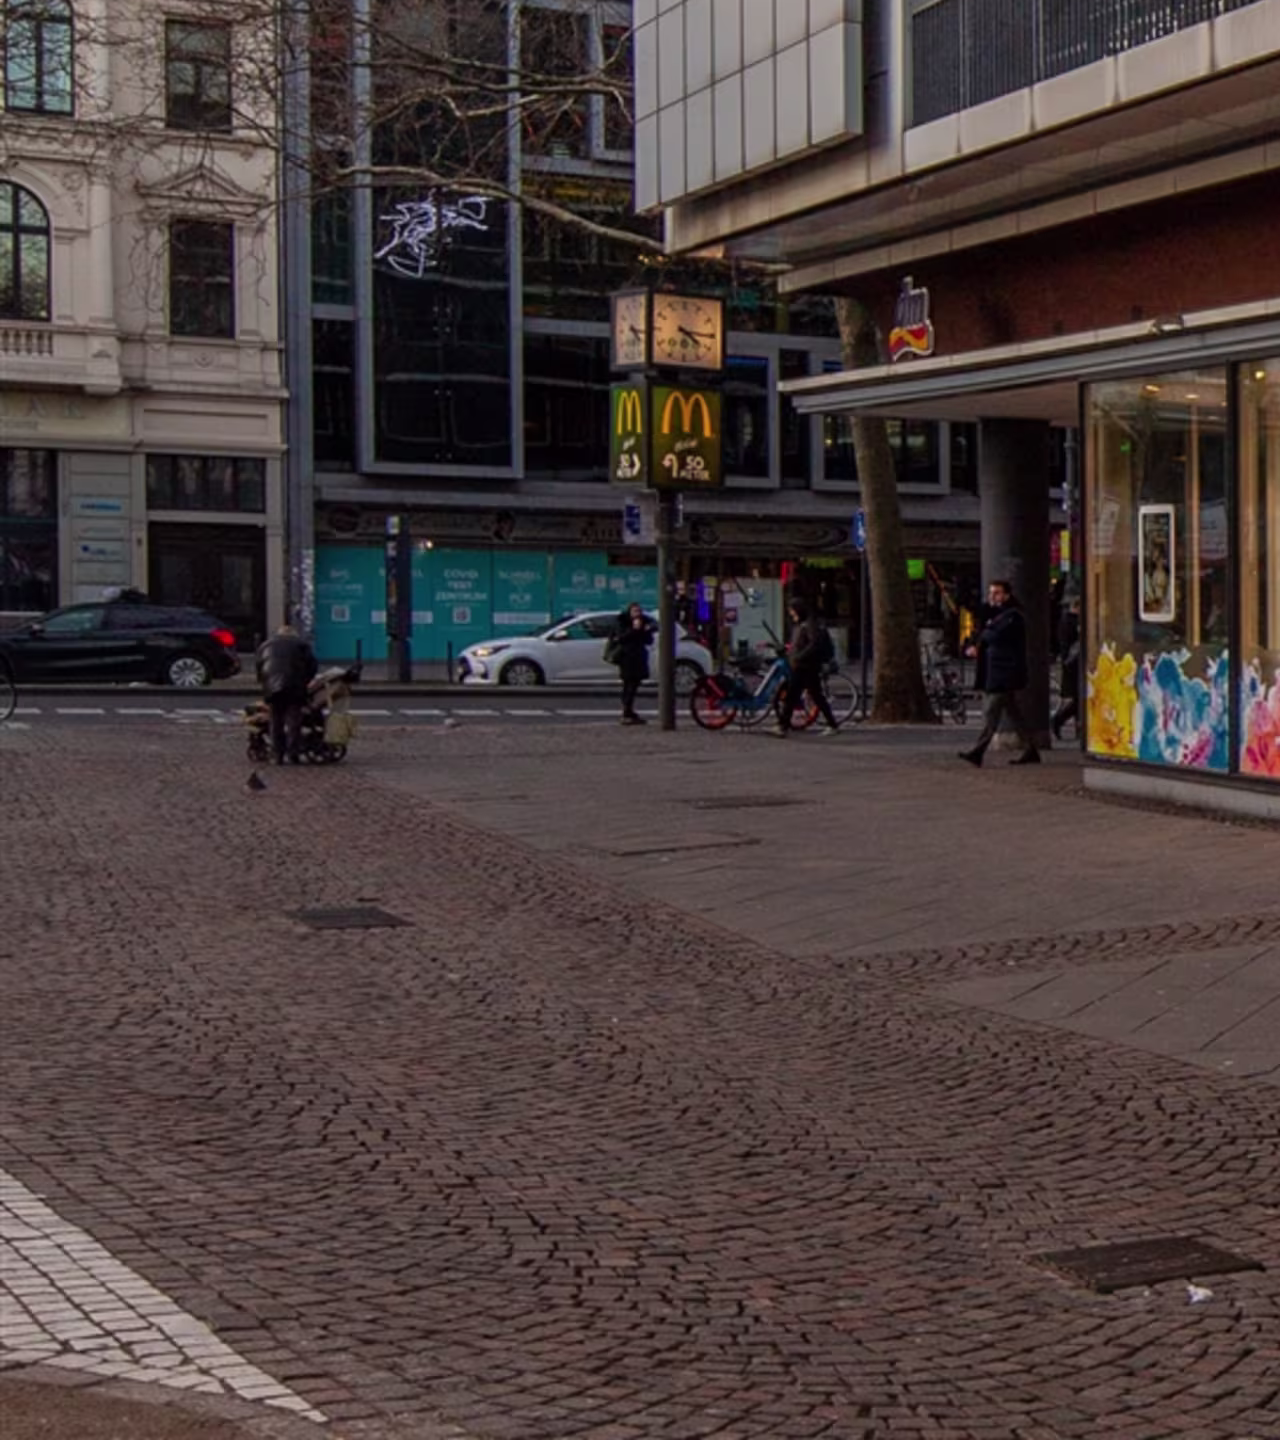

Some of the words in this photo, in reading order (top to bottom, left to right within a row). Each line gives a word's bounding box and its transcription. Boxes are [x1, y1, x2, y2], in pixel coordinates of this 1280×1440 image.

[893, 276, 928, 326] dm
[685, 454, 705, 470] 50
[443, 568, 479, 580] COVID
[447, 581, 473, 590] TEST
